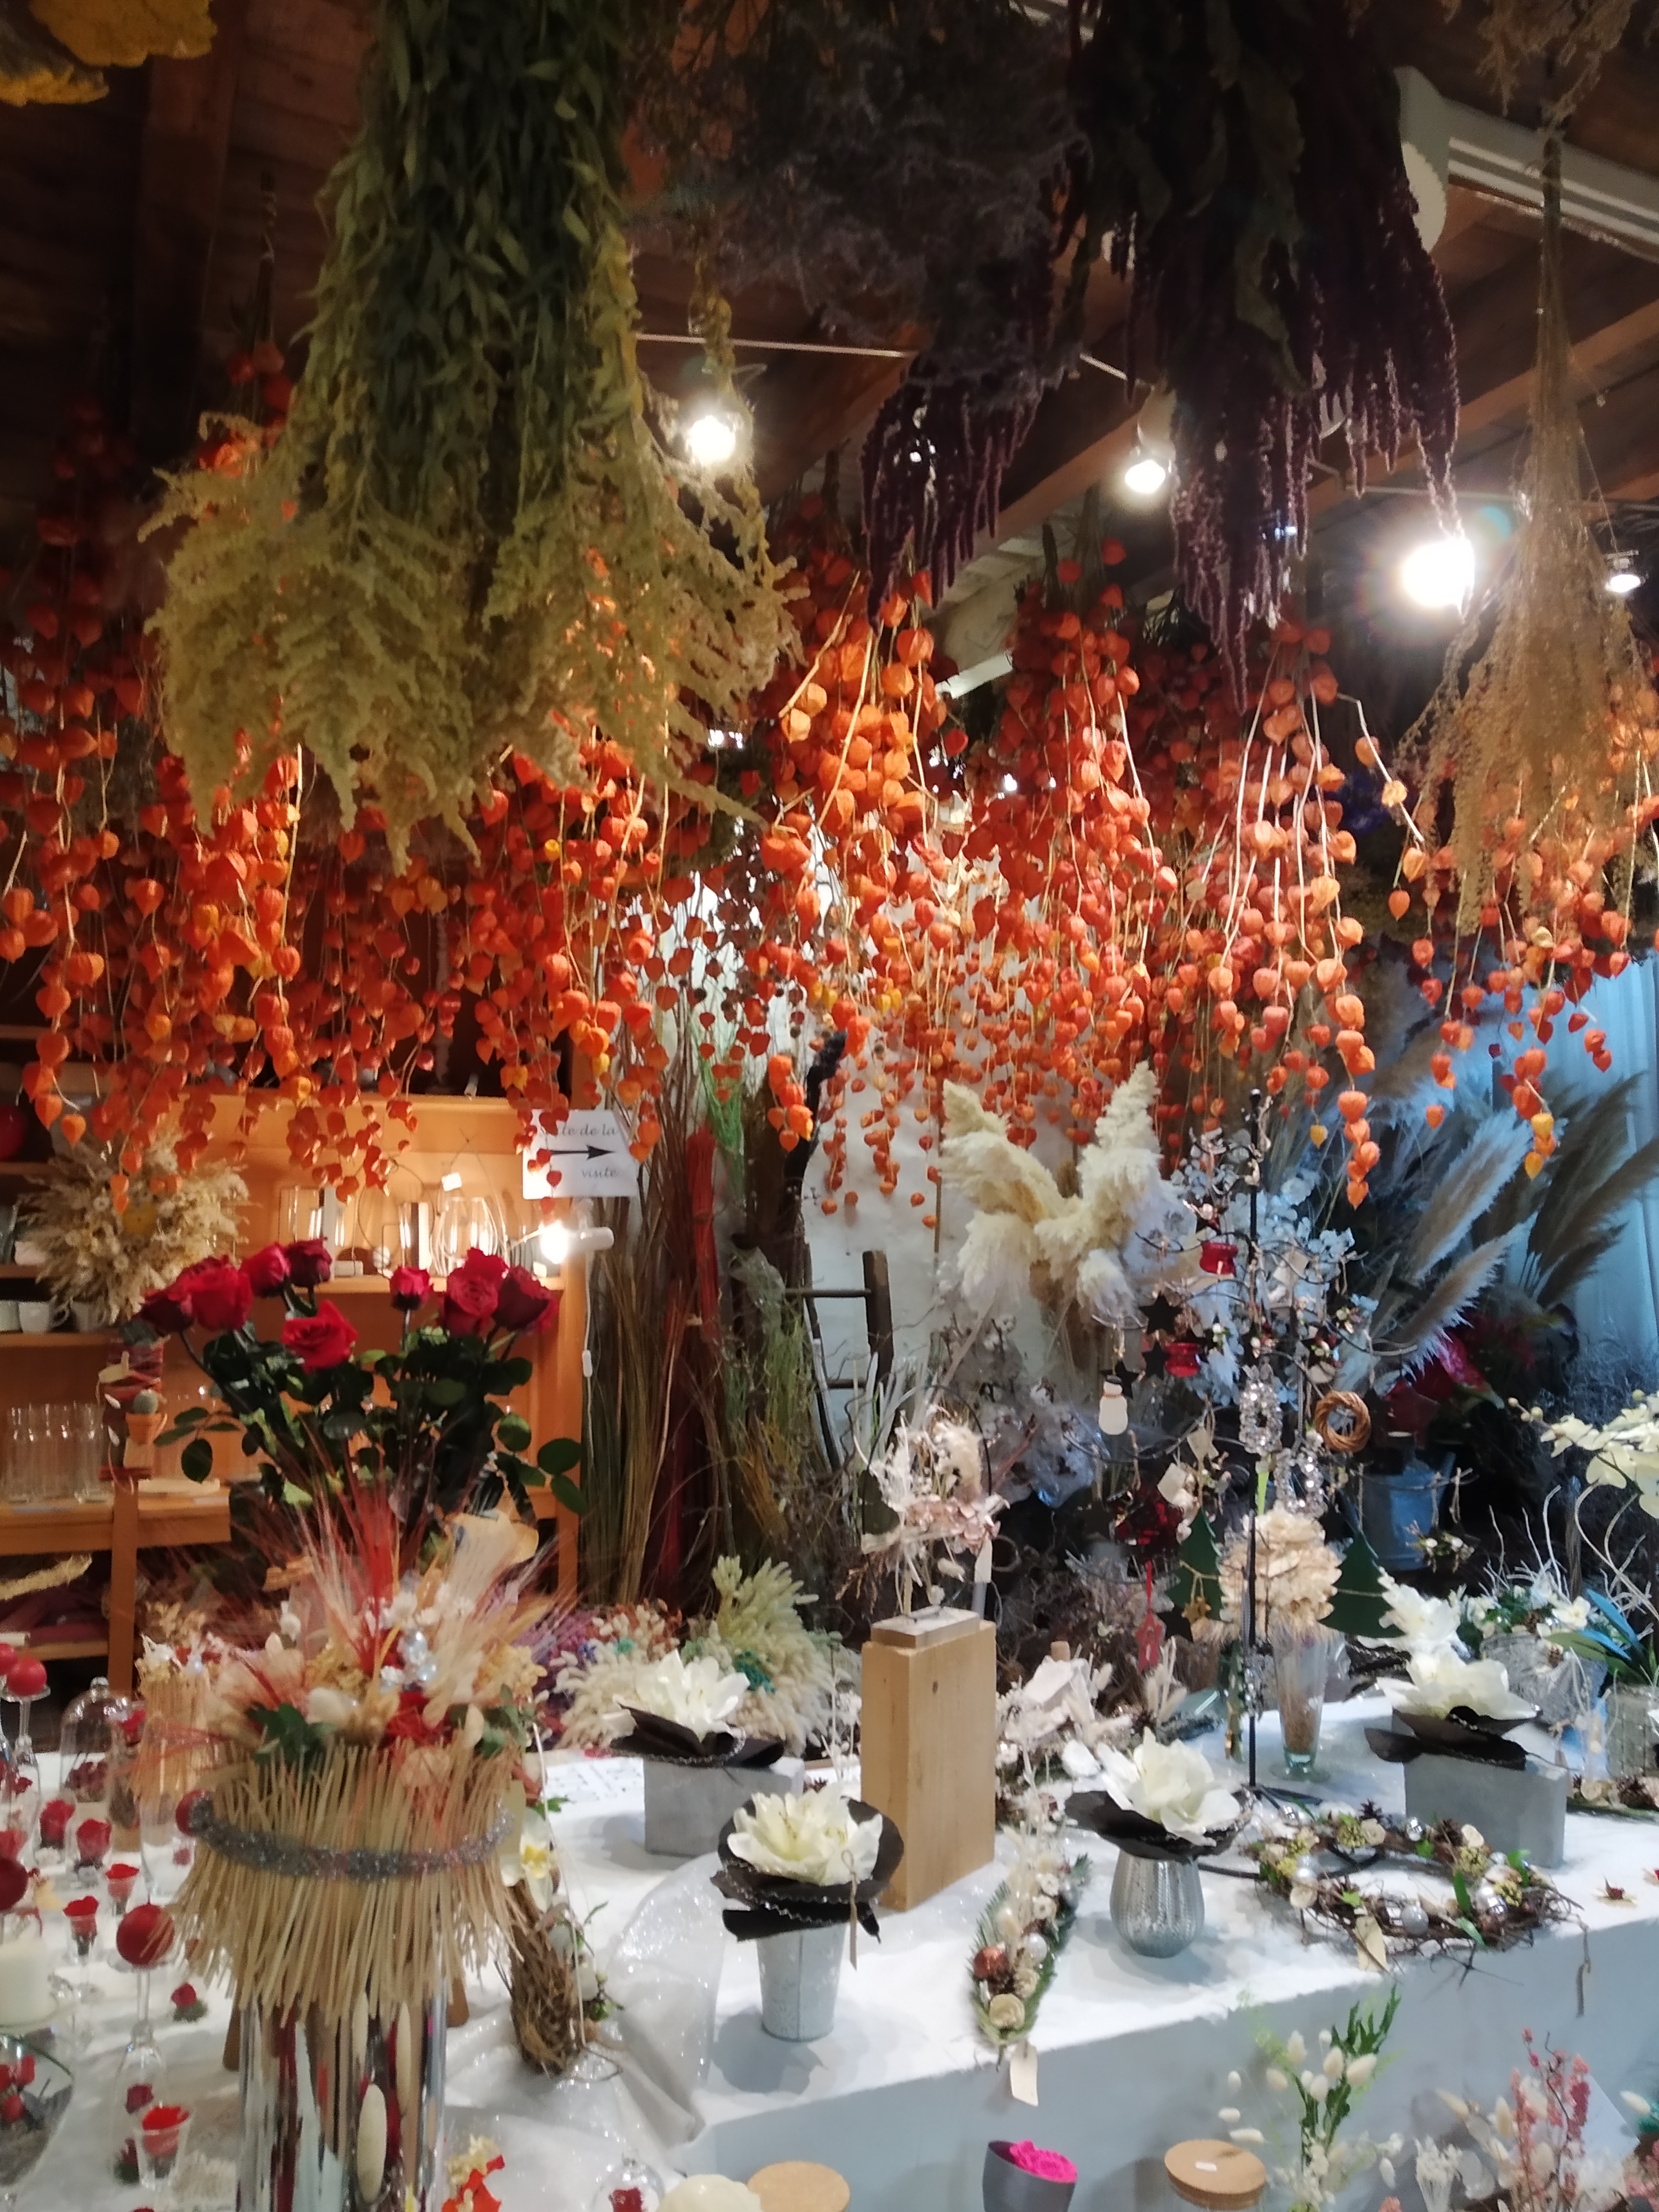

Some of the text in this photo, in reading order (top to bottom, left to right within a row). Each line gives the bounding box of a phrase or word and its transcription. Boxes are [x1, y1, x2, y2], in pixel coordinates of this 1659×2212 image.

[580, 1124, 598, 1136] de
[602, 1124, 618, 1136] la
[581, 1167, 618, 1178] visite
